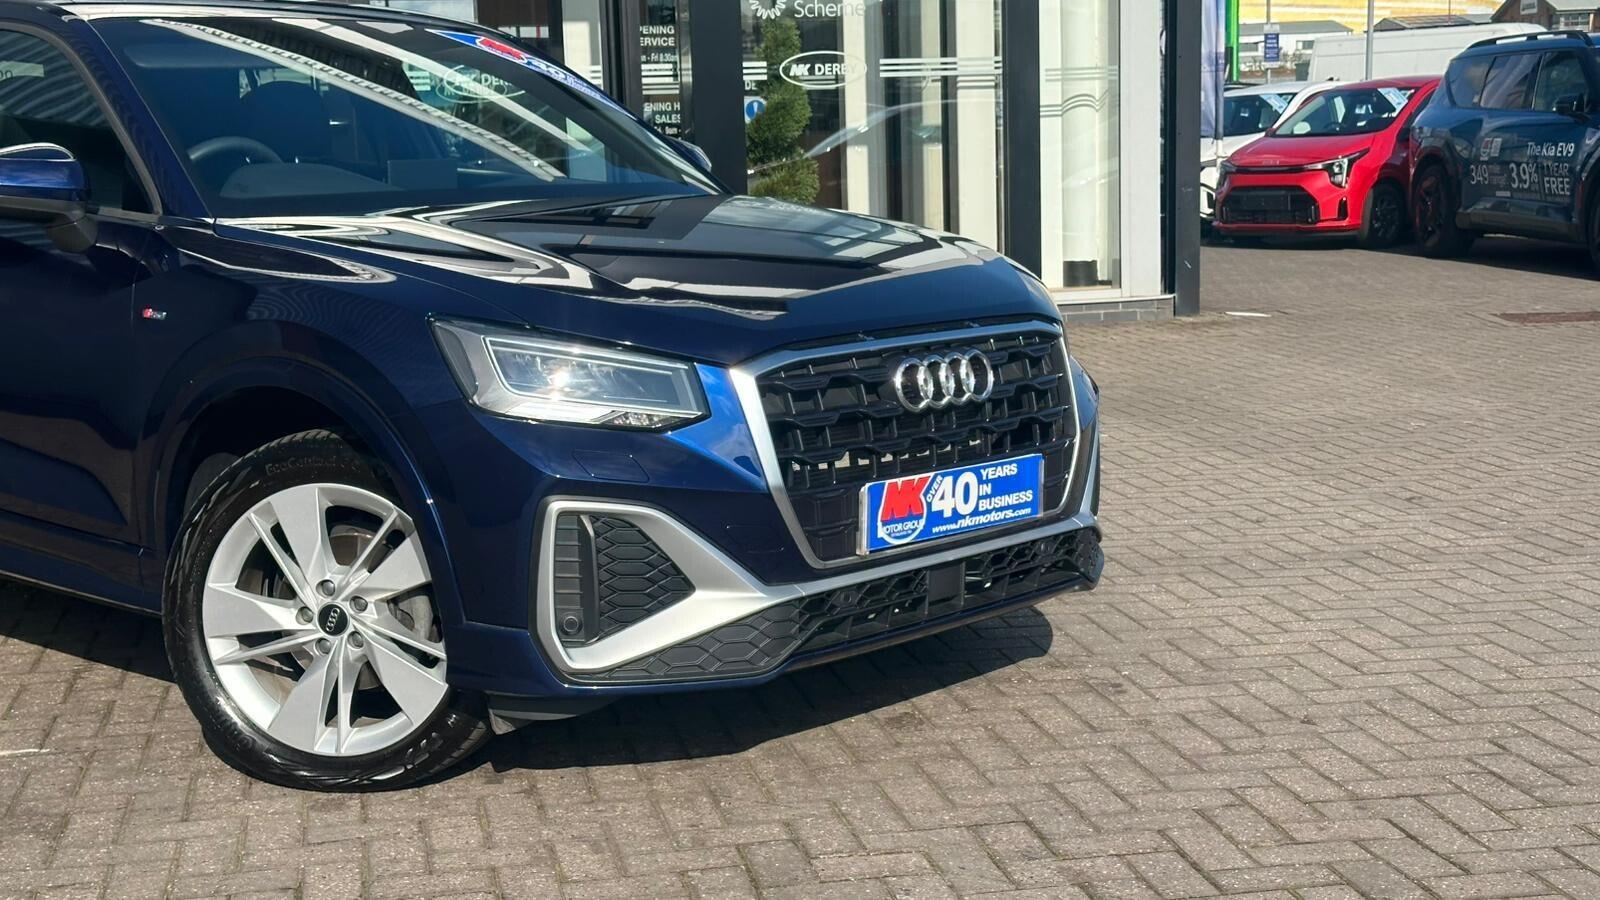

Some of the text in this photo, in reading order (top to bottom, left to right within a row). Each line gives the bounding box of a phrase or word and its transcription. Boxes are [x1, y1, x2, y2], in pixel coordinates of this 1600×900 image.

[794, 0, 866, 17] Scheme
[1527, 142, 1575, 157] The Kia EV9
[1470, 164, 1489, 184] 349
[1509, 162, 1538, 188] 3.9%
[1548, 163, 1569, 176] YEAR
[1544, 177, 1571, 195] FREE
[980, 463, 1018, 480] YEARS
[880, 475, 931, 522] NK
[926, 475, 944, 503] OVER
[931, 471, 978, 518] 40
[979, 483, 992, 496] IN
[978, 489, 1033, 511] BUSINESS
[882, 523, 903, 534] OTOR
[903, 519, 923, 531] GROU
[932, 507, 1032, 533] www.nkmotors.com
